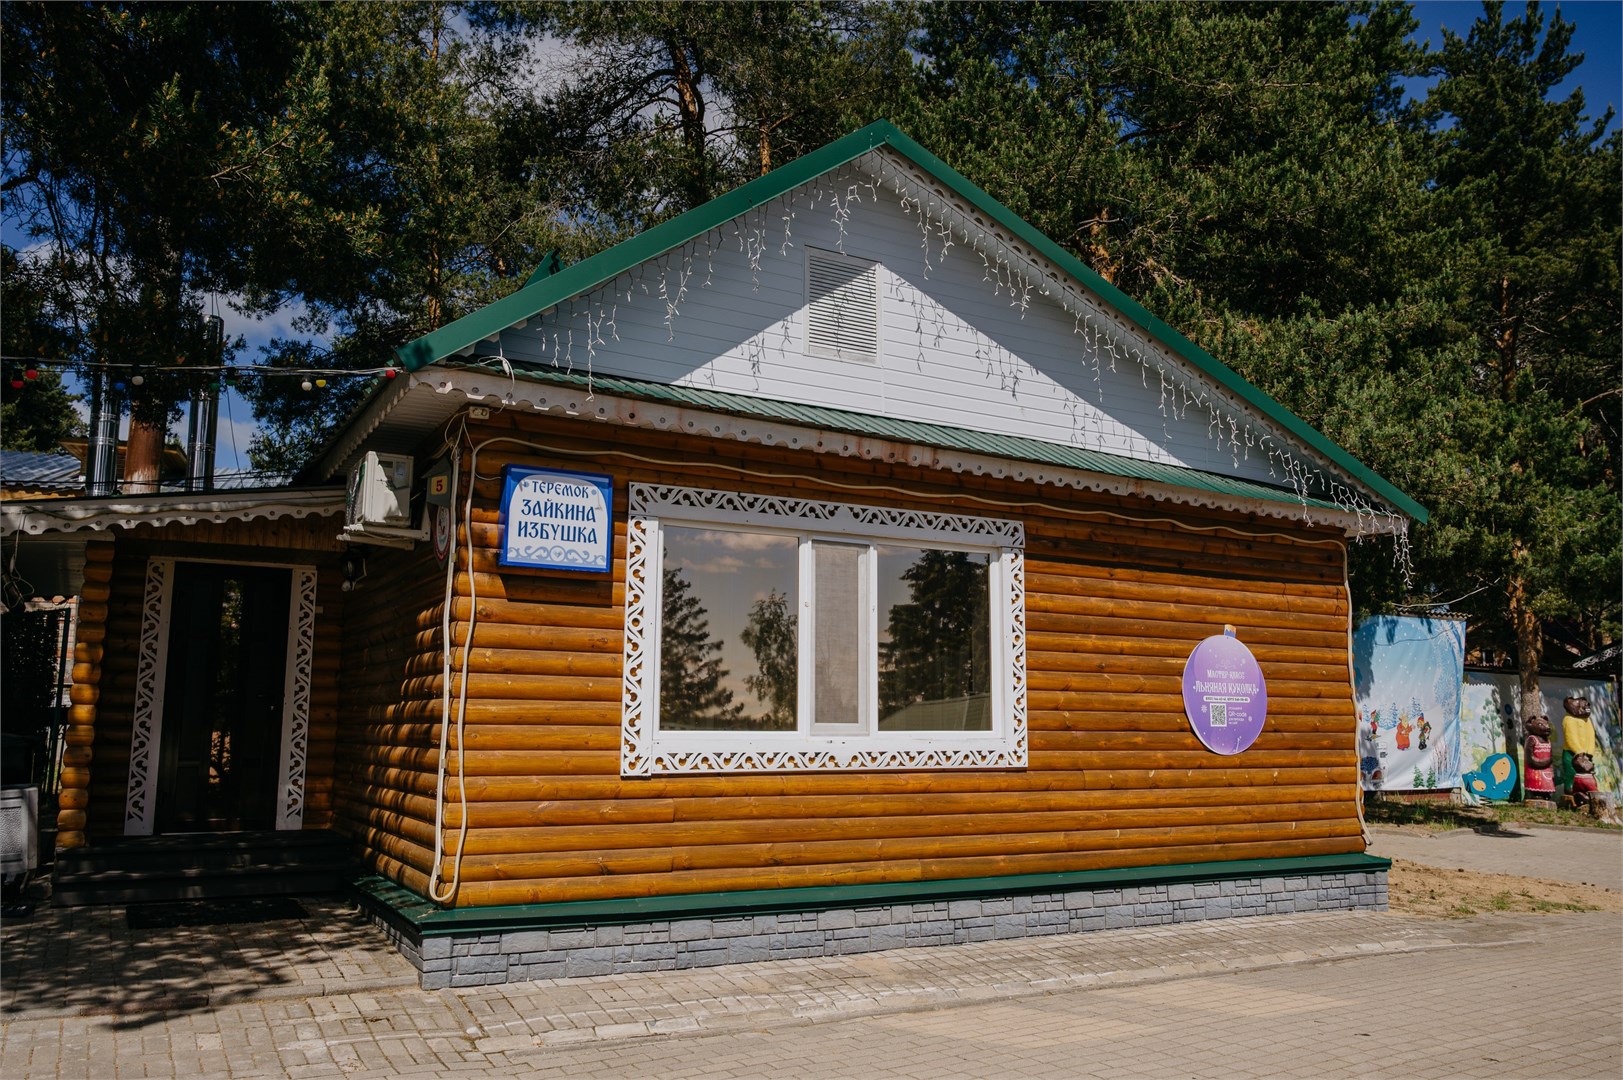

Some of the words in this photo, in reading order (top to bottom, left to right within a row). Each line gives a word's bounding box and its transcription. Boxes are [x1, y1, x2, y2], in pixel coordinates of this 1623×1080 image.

[436, 479, 443, 492] 5
[532, 480, 589, 498] ТЕРЕМОК
[521, 498, 596, 522] ЗАЙКИНА
[517, 520, 597, 544] ИЗБУШКА
